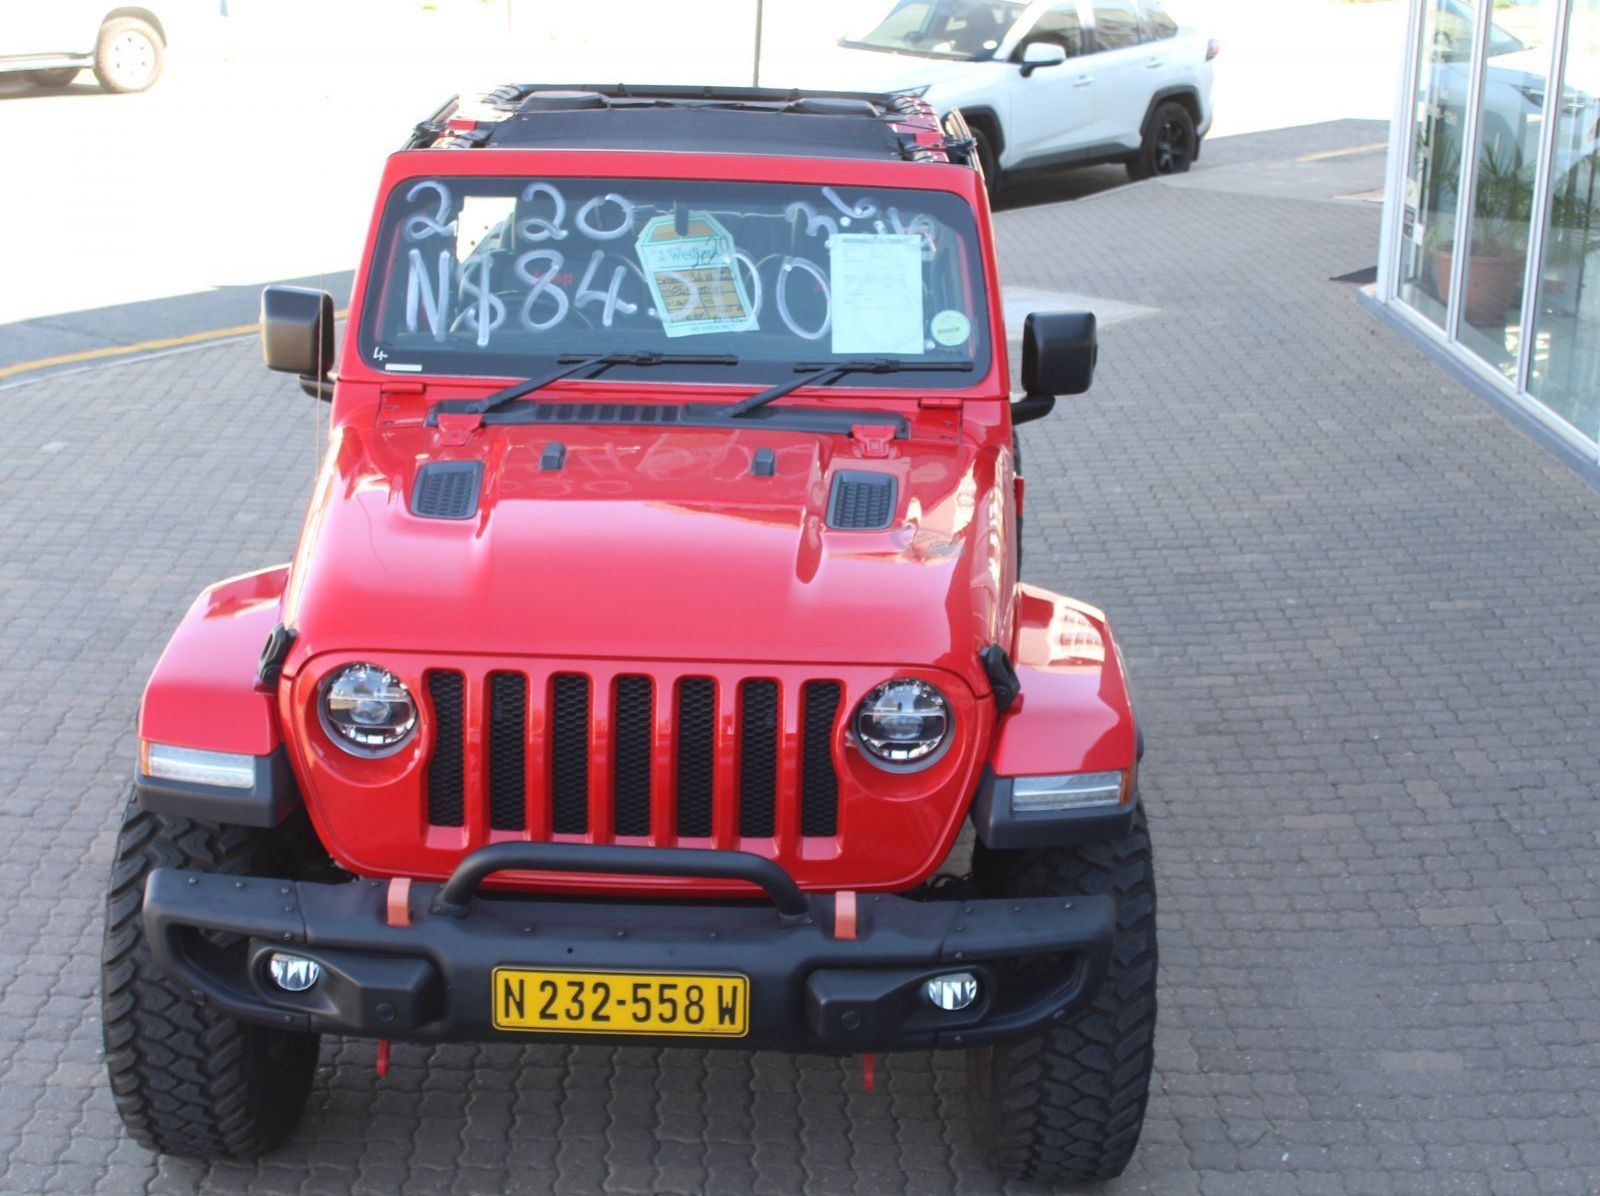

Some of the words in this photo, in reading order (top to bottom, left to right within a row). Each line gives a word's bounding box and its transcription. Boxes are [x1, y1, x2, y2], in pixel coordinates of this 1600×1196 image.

[504, 978, 525, 1019] N
[539, 980, 705, 1025] 232-558
[717, 985, 738, 1025] W
